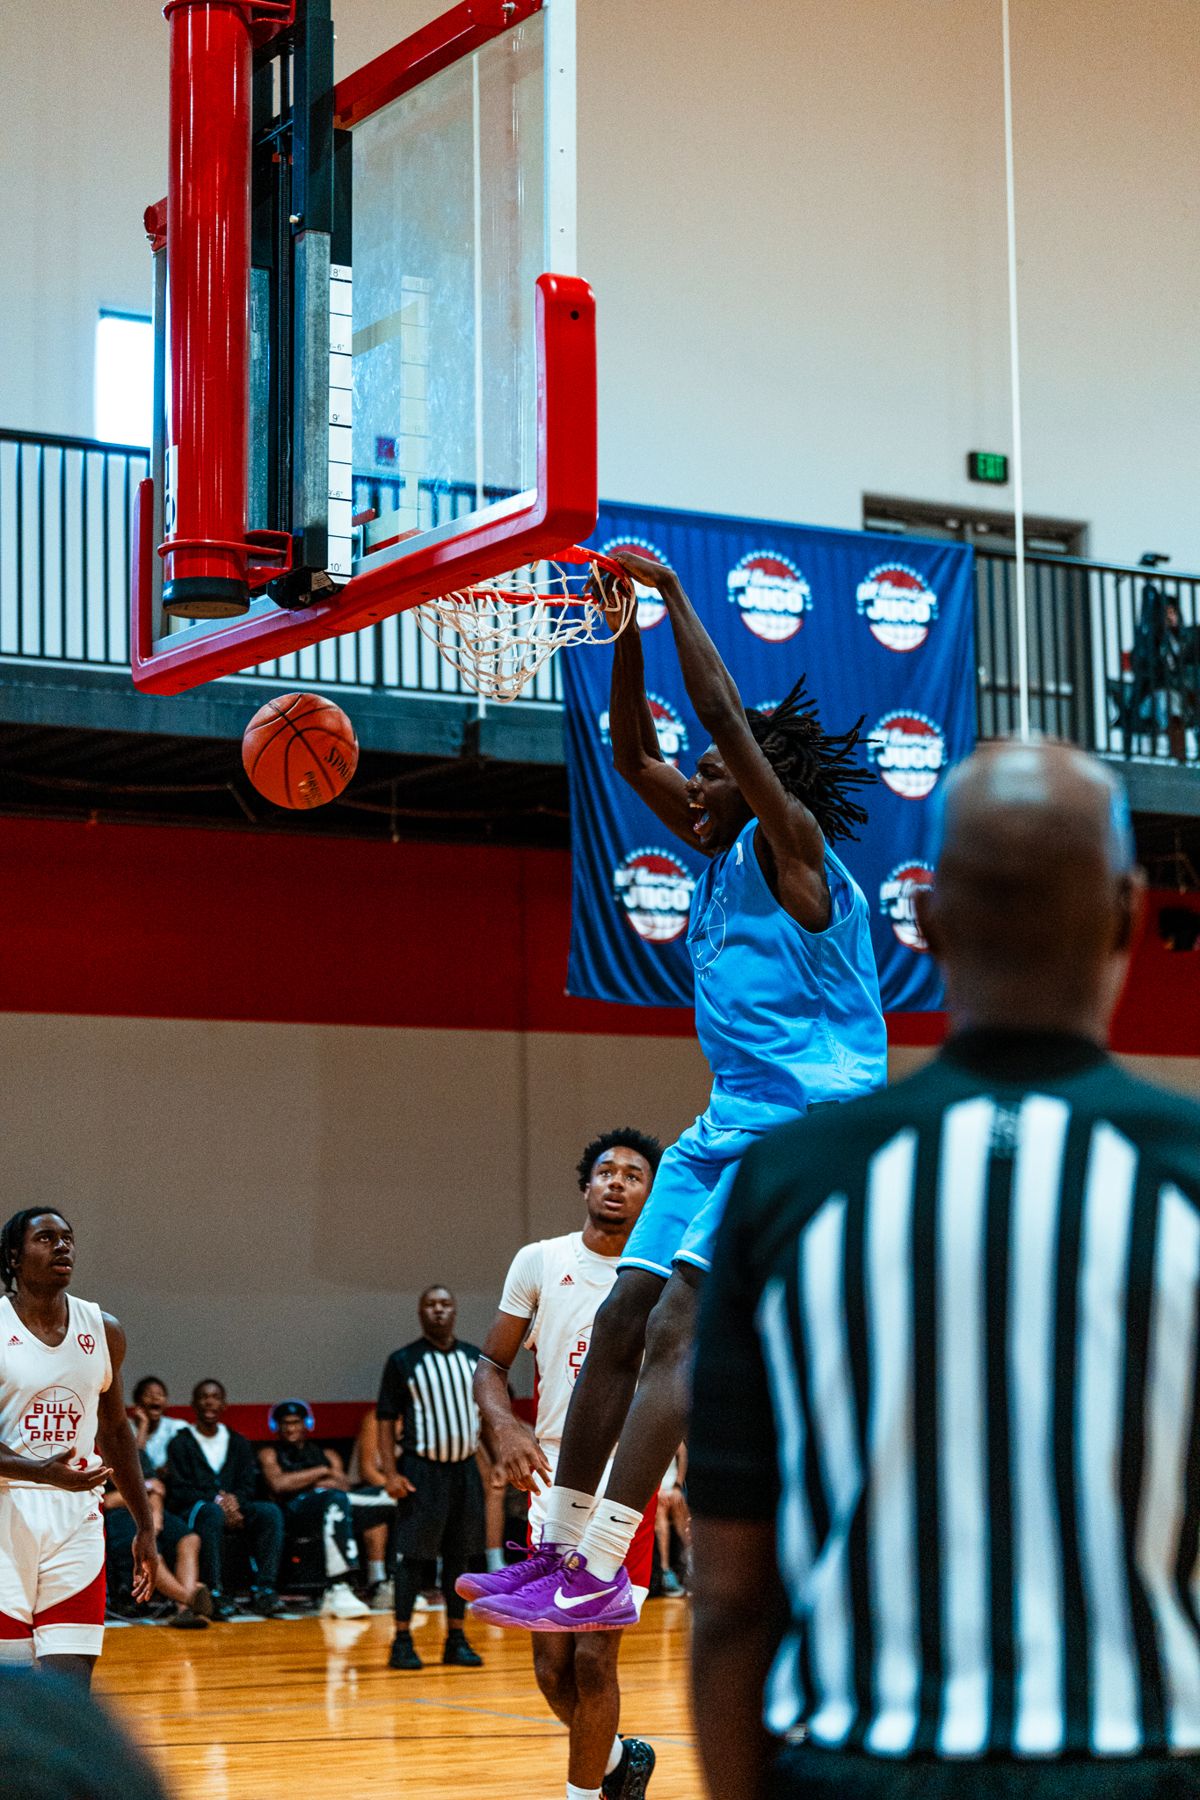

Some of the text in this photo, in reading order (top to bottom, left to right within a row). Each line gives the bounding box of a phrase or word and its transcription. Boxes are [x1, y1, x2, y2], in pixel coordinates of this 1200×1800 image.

[622, 886, 690, 911] JUCO
[33, 1403, 78, 1414] BULL
[24, 1415, 82, 1430] CITY
[30, 1431, 77, 1442] PREP
